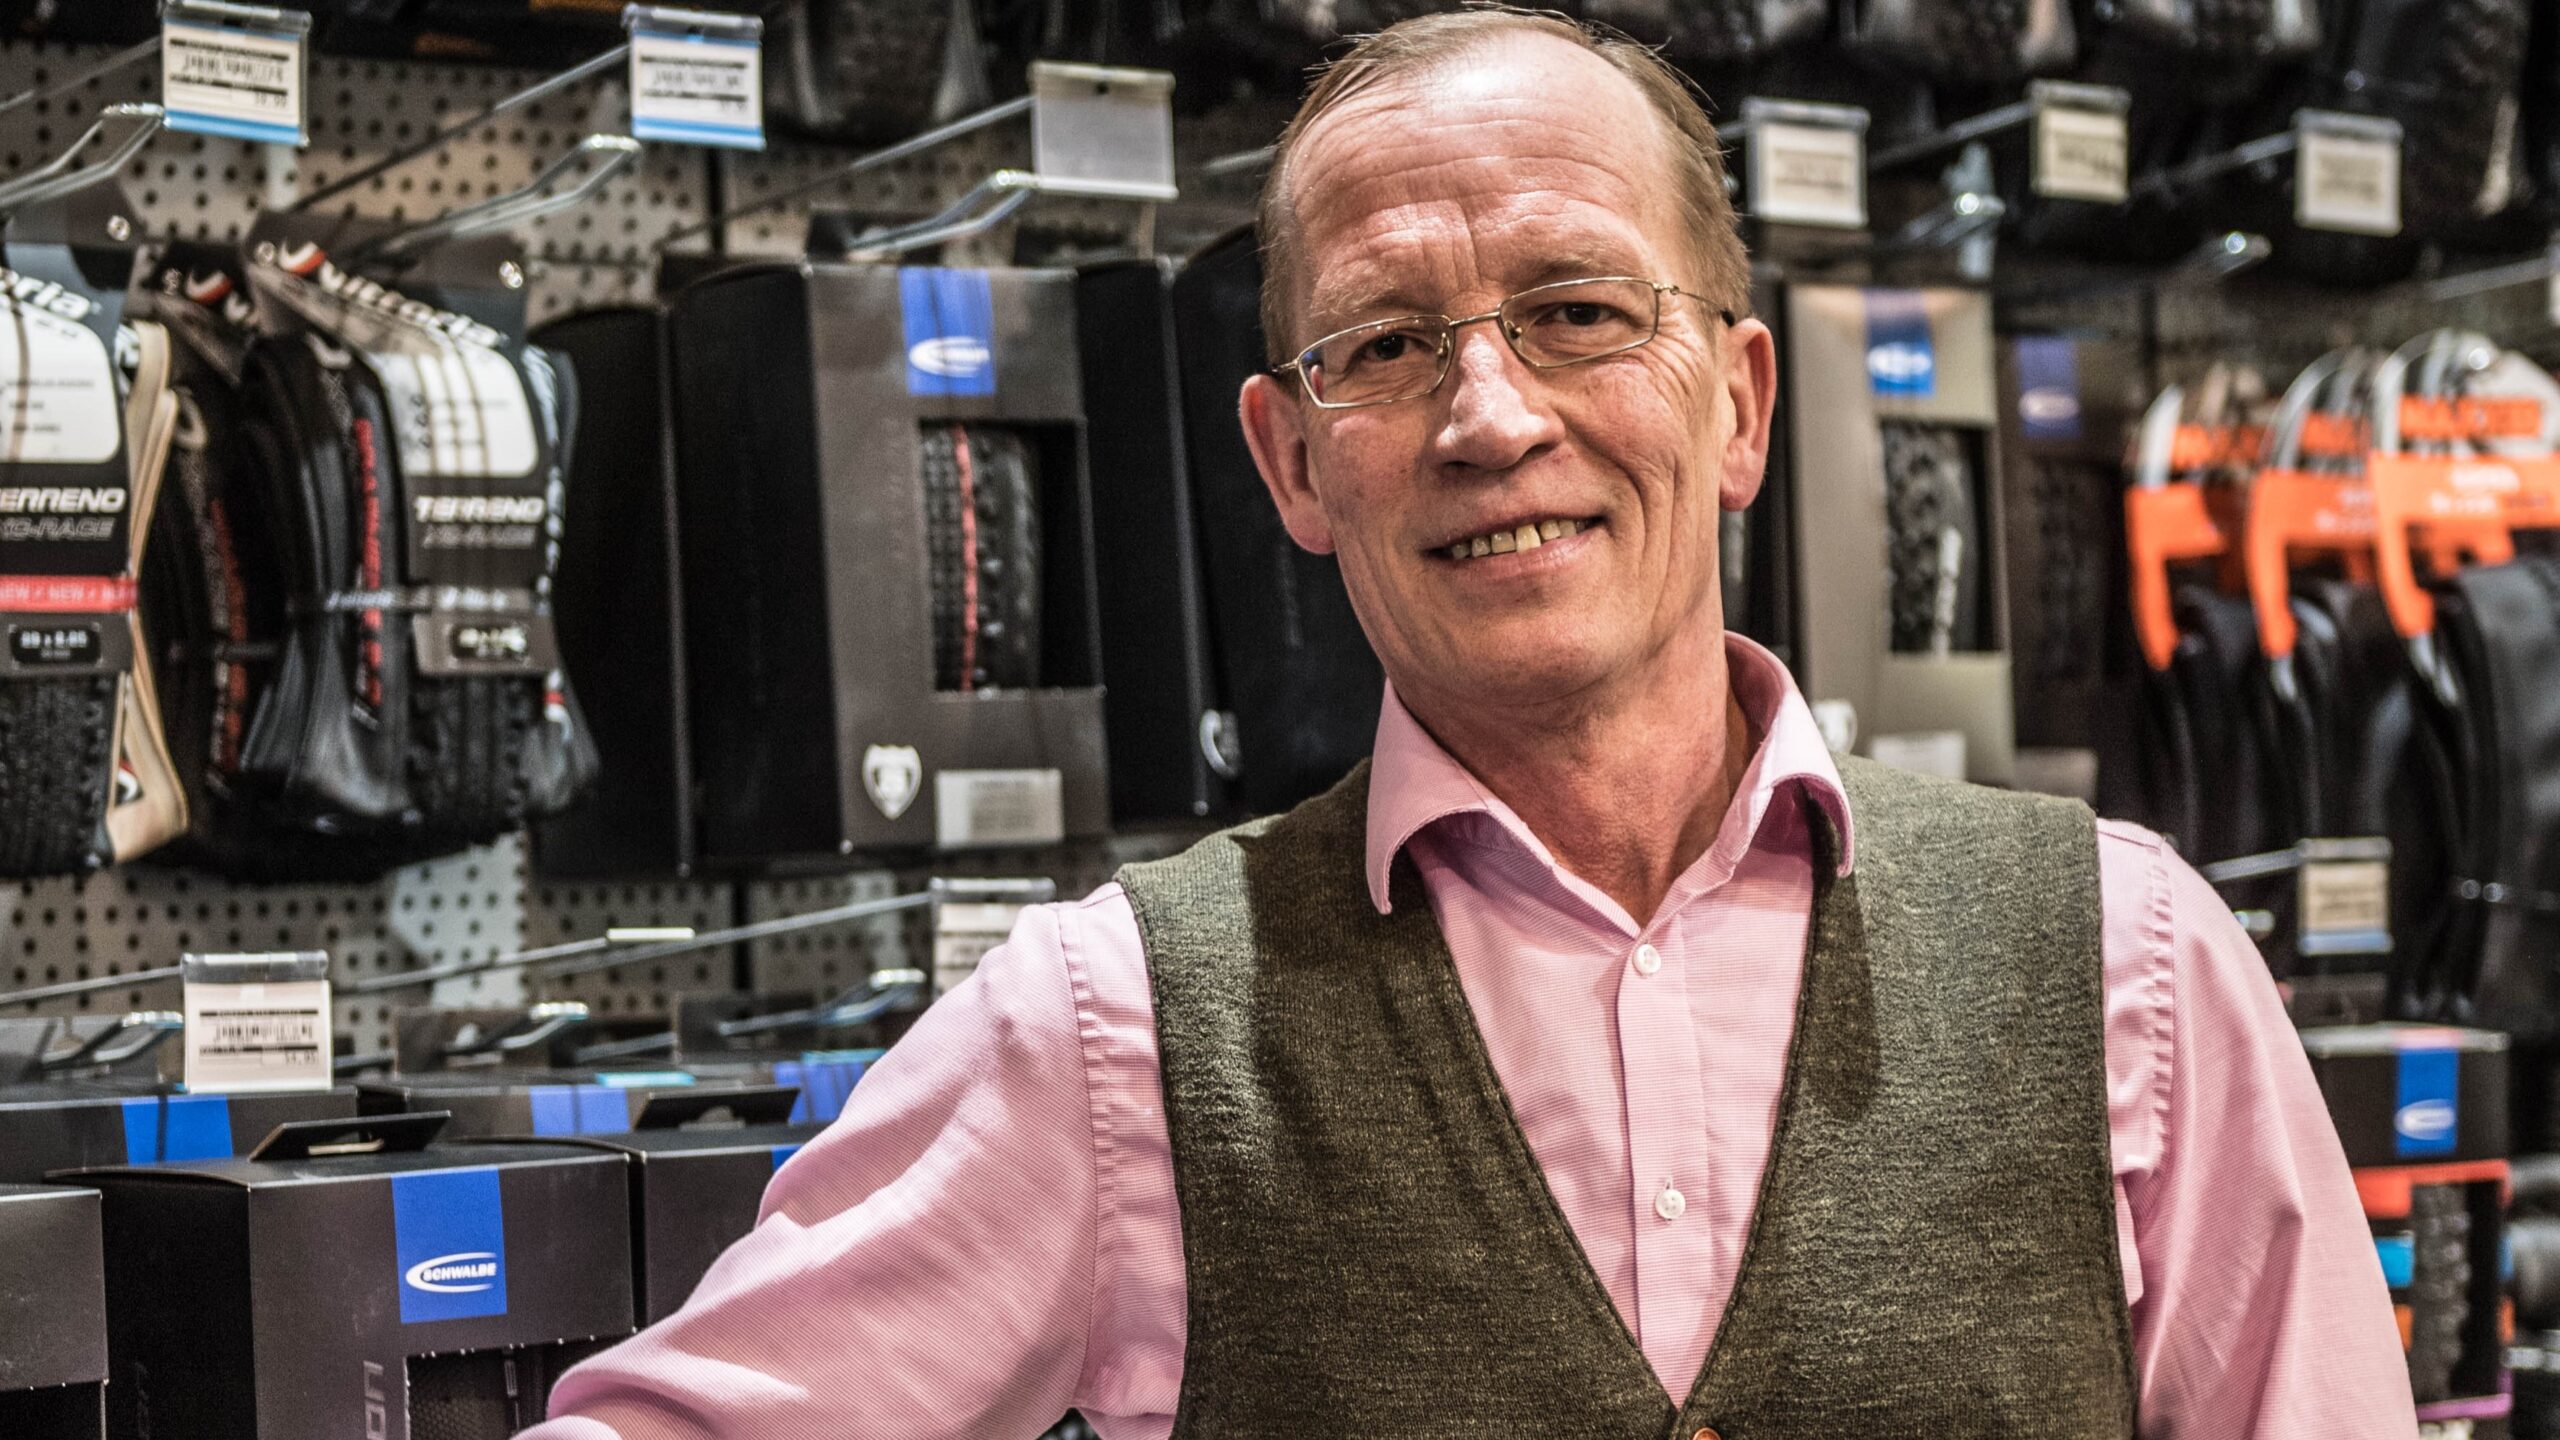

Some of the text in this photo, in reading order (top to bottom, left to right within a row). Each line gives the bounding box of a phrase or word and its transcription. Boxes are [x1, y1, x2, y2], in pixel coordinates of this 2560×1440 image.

[0, 487, 126, 513] ERRENO
[415, 496, 545, 523] TERRENO
[422, 1262, 498, 1284] SCHWALBE
